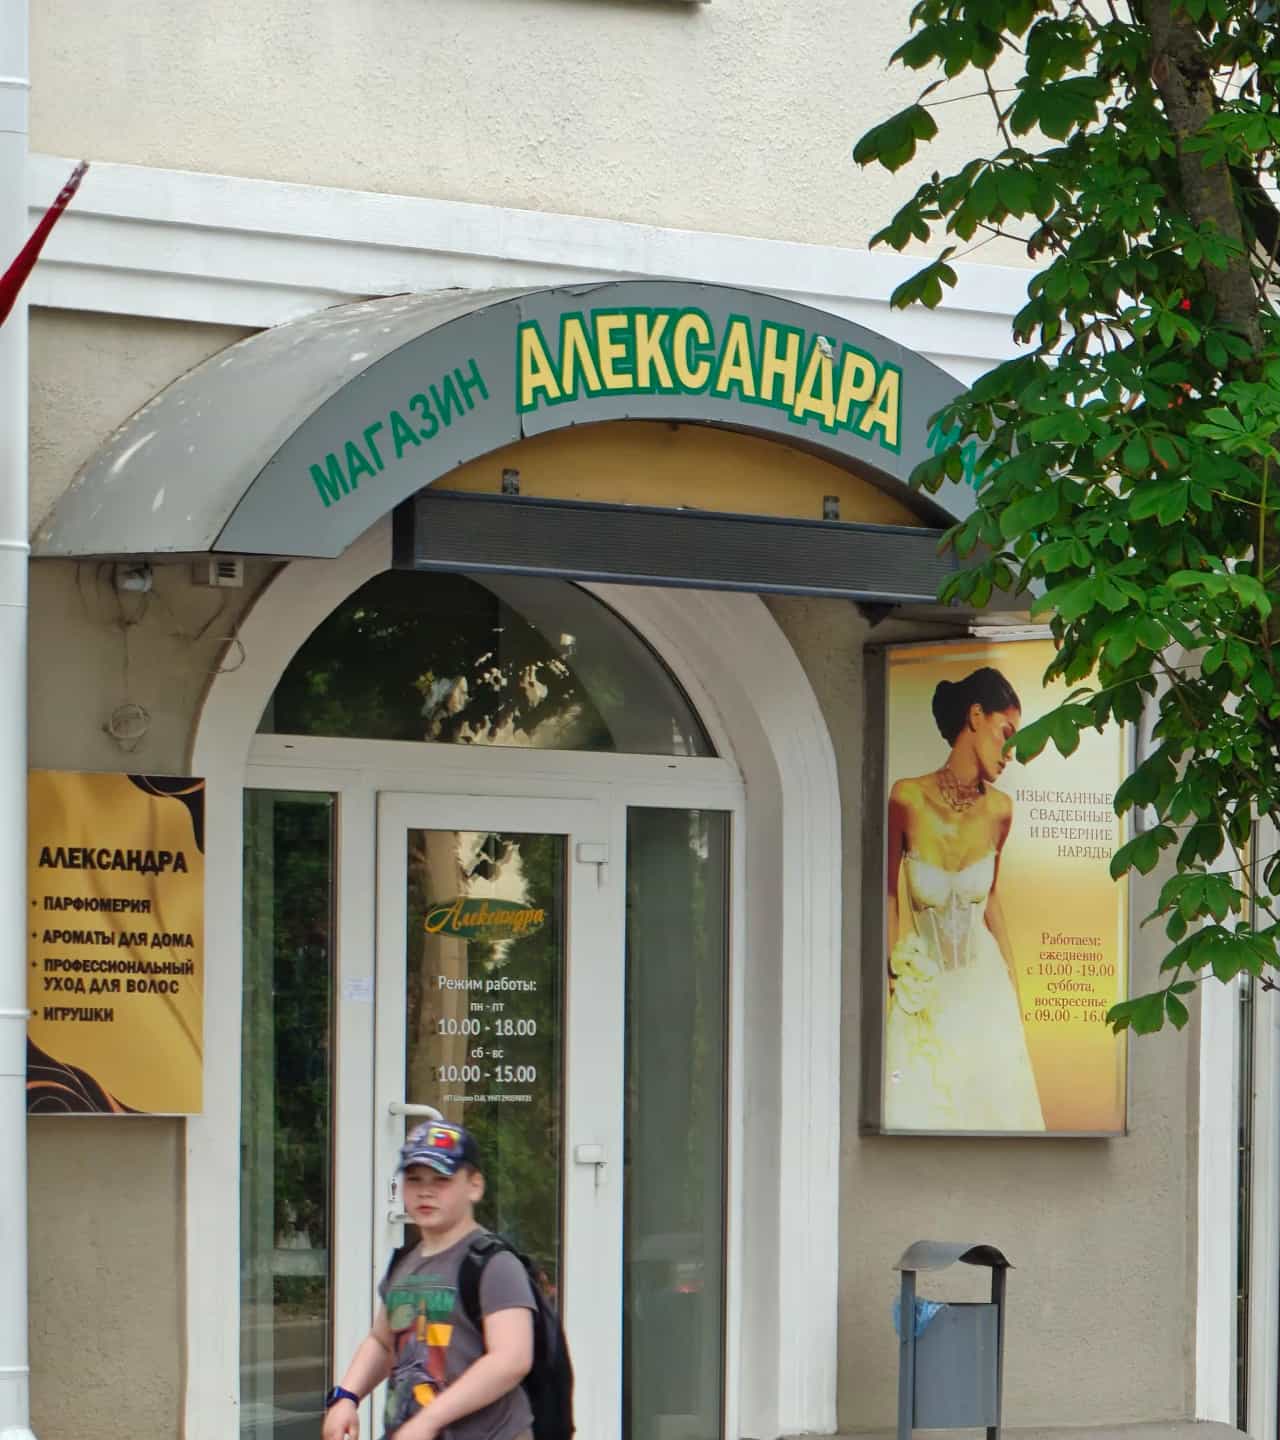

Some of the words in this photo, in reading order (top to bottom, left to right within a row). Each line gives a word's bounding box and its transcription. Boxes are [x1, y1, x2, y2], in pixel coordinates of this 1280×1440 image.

[311, 359, 488, 506] МАГАЗИН
[517, 308, 902, 454] АЛЕКСАНДРА
[1016, 789, 1113, 805] ИЗЫСКАННЫЕ
[1030, 808, 1113, 822] СВАДЕБНЫЕ
[1030, 826, 1039, 838] И
[1042, 826, 1112, 840] ВЕЧЕРНИЕ
[1057, 845, 1112, 859] НАРЯДЫ
[39, 847, 188, 876] АЛЕКСАНДРА
[44, 896, 151, 913] ПАРФЮМЕРИЯ
[43, 930, 115, 947] АРОМАТЫ
[118, 933, 148, 948] ДЛЯ
[151, 933, 194, 949] ДОМА
[1041, 932, 1101, 946] Работаем:
[1040, 952, 1103, 961] ежедневно
[44, 959, 194, 976] ПРОФЕССИОНАЛЬНЫЙ
[1038, 963, 1072, 976] 10.00
[44, 977, 86, 995] УХОД
[89, 978, 120, 994] ДЛЯ
[126, 979, 179, 994] ВОЛОС
[438, 976, 483, 990] Режим
[486, 977, 537, 992] работы:
[1047, 980, 1095, 993] суббота,
[470, 1003, 483, 1011] пн
[492, 1003, 504, 1011] пт
[1034, 997, 1107, 1009] воскресенье
[43, 1007, 114, 1022] ИГРУШКИ
[1034, 1009, 1070, 1021] 09.00
[1083, 1010, 1107, 1022] 16.0
[438, 1019, 480, 1035] 10.00
[495, 1019, 537, 1036] 18.00
[471, 1047, 484, 1058] сб
[492, 1050, 504, 1058] вс
[439, 1065, 480, 1082] 10.00
[495, 1065, 537, 1082] 15.00
